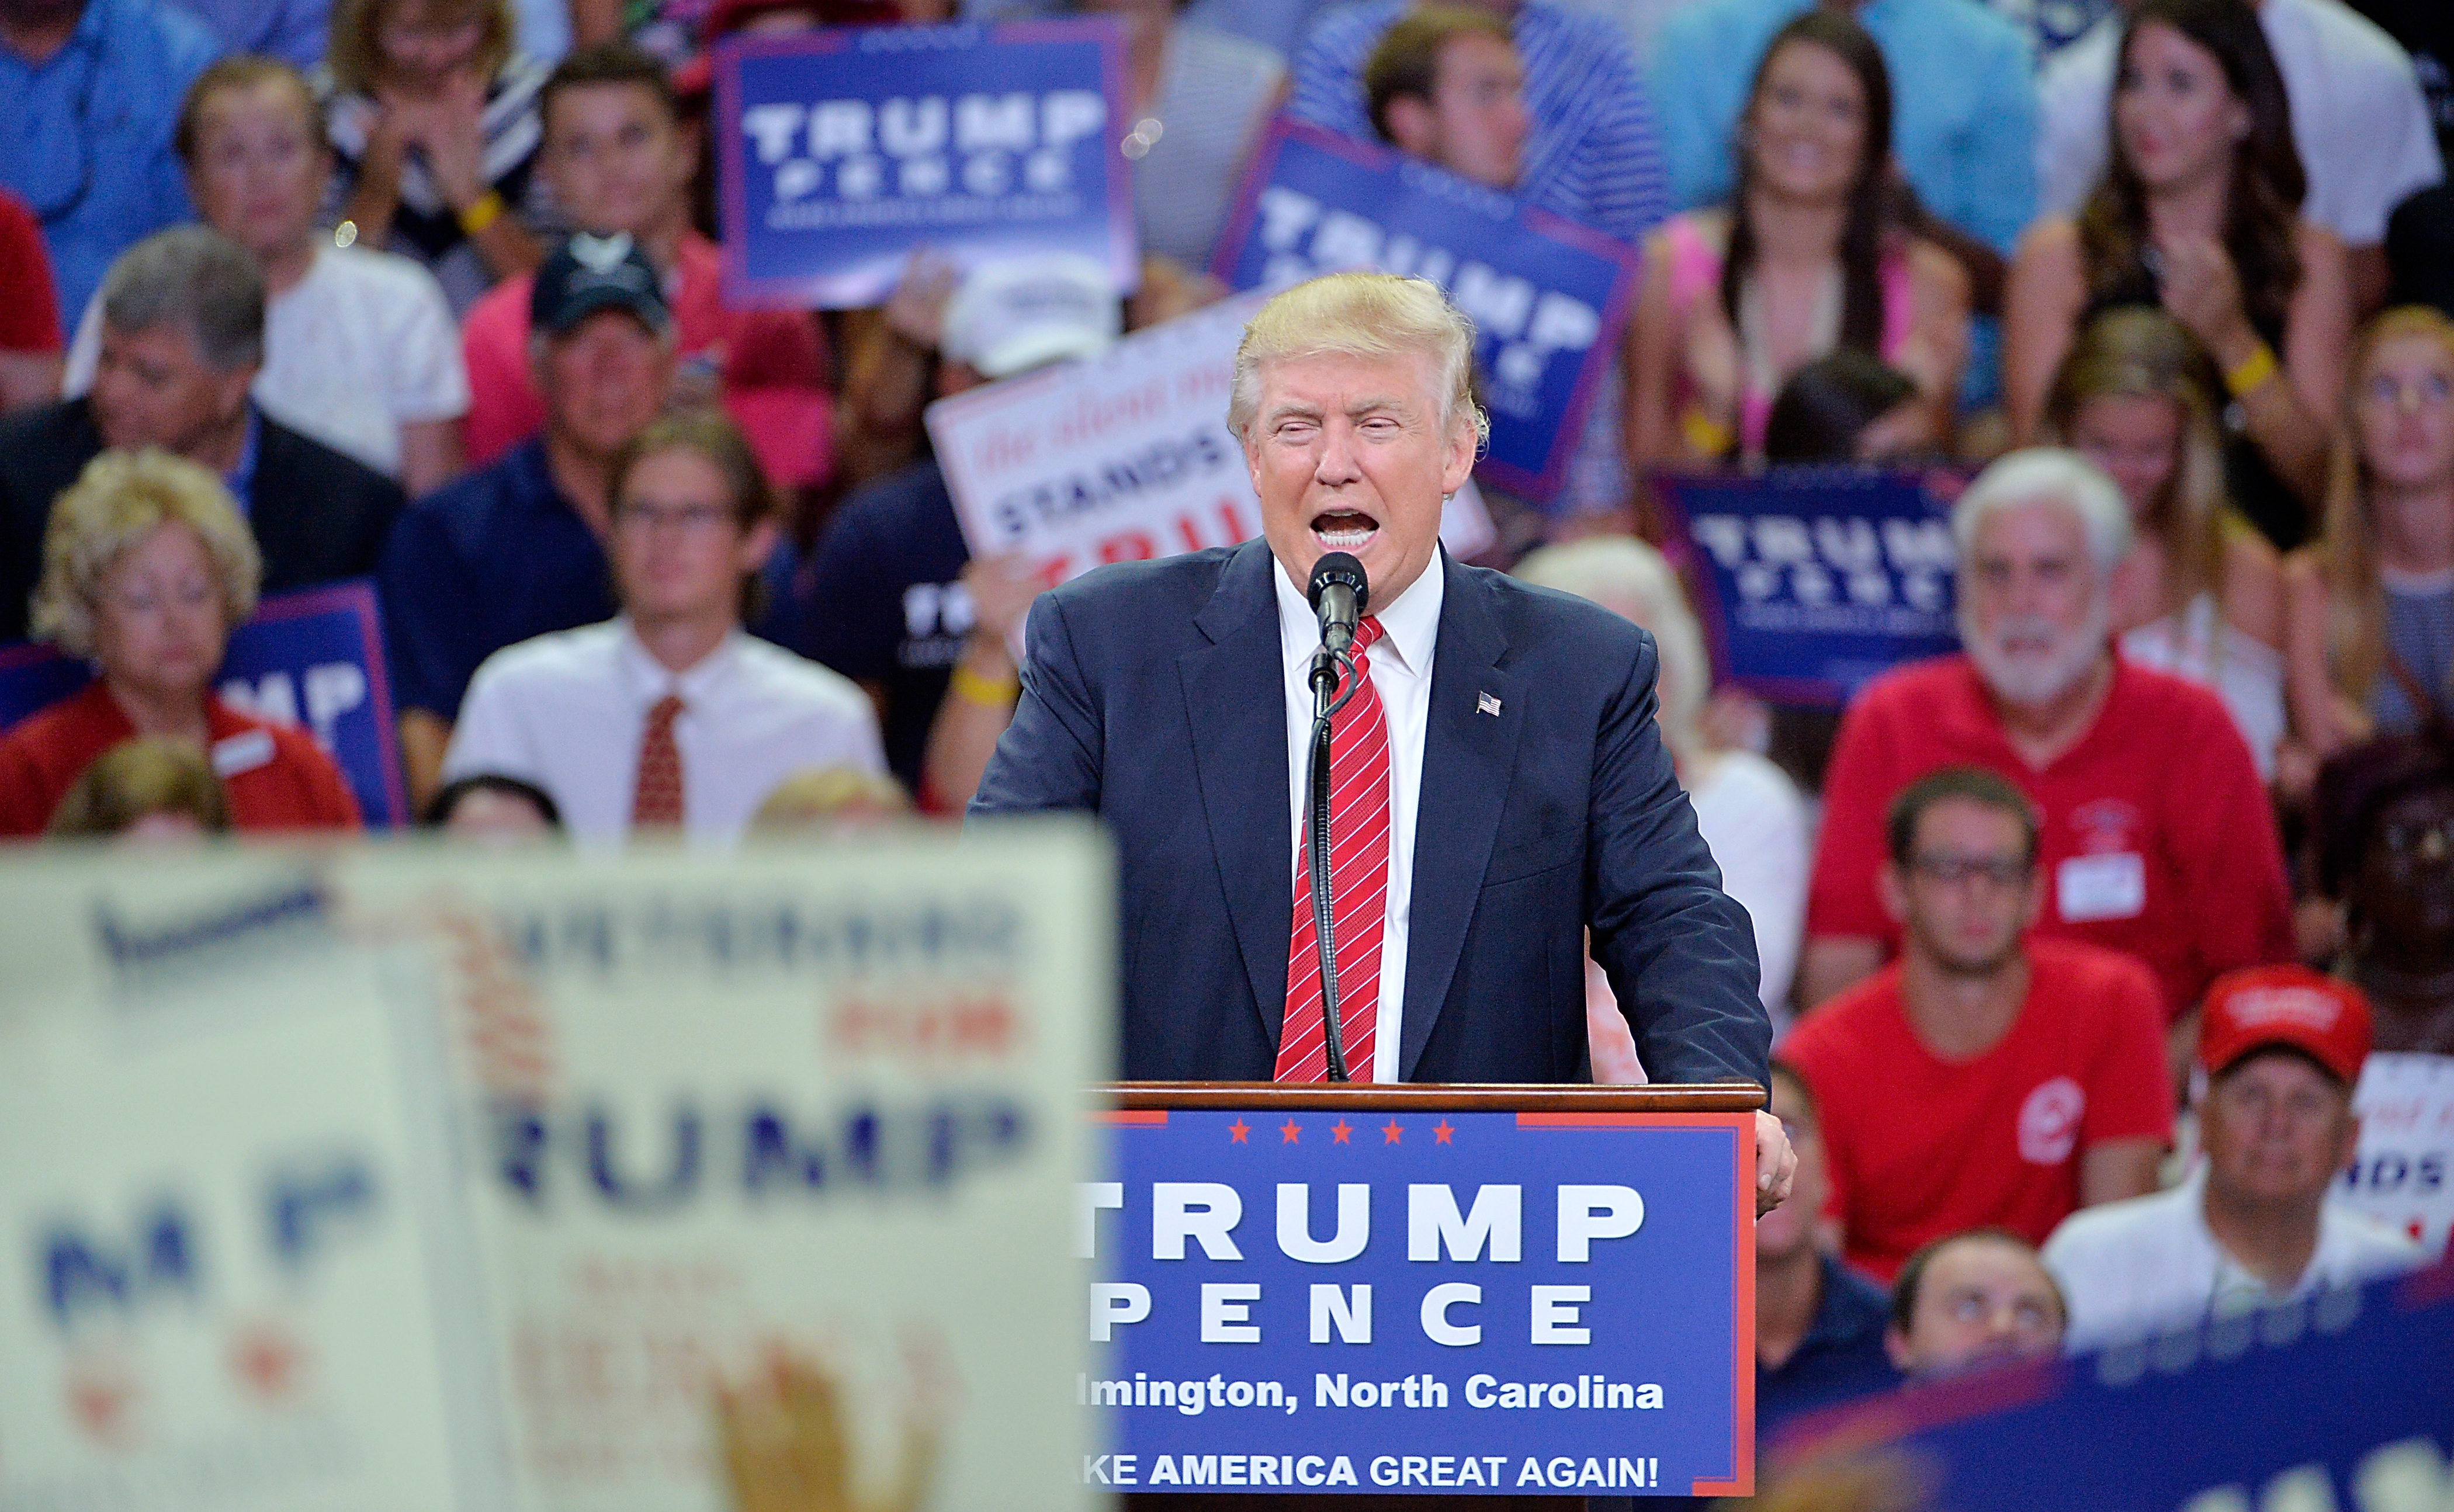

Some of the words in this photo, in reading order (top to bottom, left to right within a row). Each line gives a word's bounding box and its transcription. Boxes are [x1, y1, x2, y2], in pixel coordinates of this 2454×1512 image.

[742, 89, 1106, 165] TRUMP
[996, 425, 1226, 539] STANDS
[1075, 1181, 1644, 1264] TRUMP
[1090, 1282, 1591, 1347] PENCE
[1315, 1373, 1449, 1409] North
[1464, 1374, 1664, 1410] Carolina
[1075, 1455, 1137, 1484] KE
[1149, 1455, 1358, 1486] AMERICA
[1369, 1456, 1507, 1487] GREAT
[1516, 1457, 1659, 1488] AGAIN!
